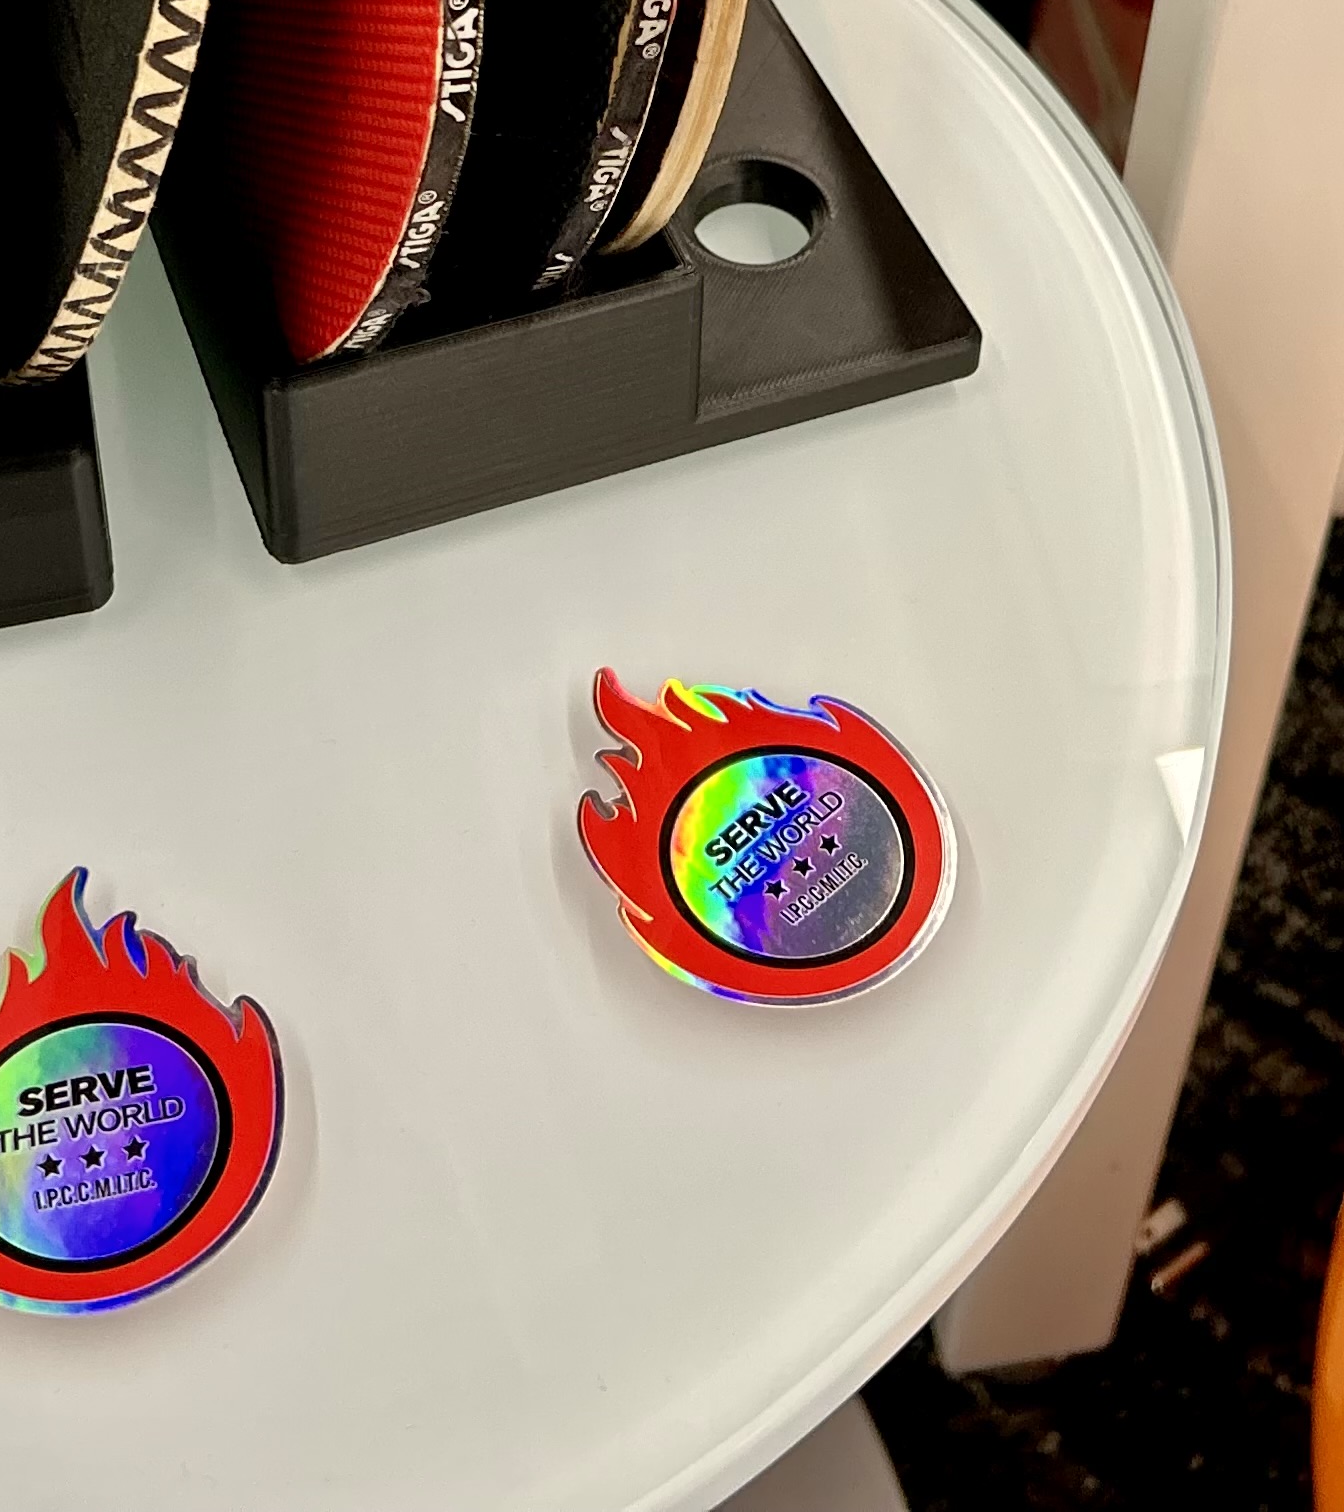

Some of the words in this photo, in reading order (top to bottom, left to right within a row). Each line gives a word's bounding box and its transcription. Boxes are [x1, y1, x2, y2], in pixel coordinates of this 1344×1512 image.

[704, 780, 808, 867] SERVE
[708, 855, 766, 900] THE
[756, 790, 844, 863] WORLD
[17, 1065, 156, 1118] SERVE
[63, 1096, 185, 1140] WORLD
